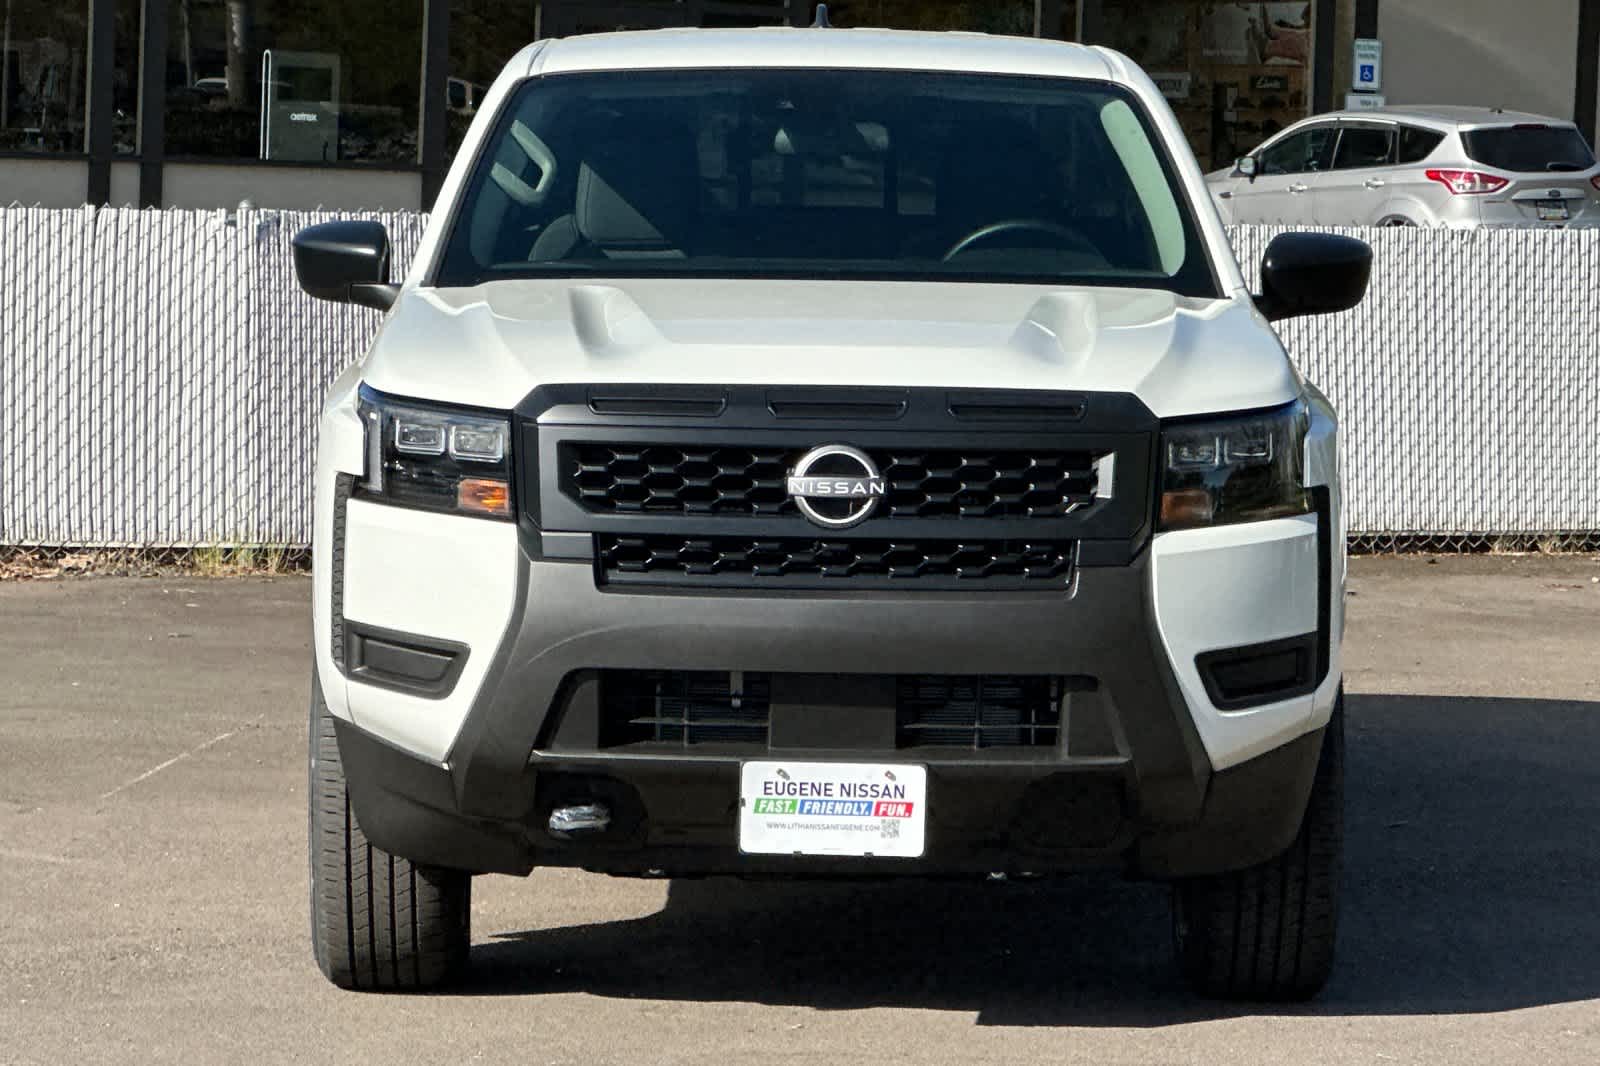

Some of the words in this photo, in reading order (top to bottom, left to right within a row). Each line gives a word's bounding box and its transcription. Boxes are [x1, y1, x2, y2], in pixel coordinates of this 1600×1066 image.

[790, 482, 884, 494] NISSAN
[763, 781, 833, 797] EUGENE
[840, 783, 905, 799] NISSAN
[758, 800, 794, 813] FAST.
[803, 800, 869, 815] FRIENDLY.
[879, 803, 910, 817] FUN.
